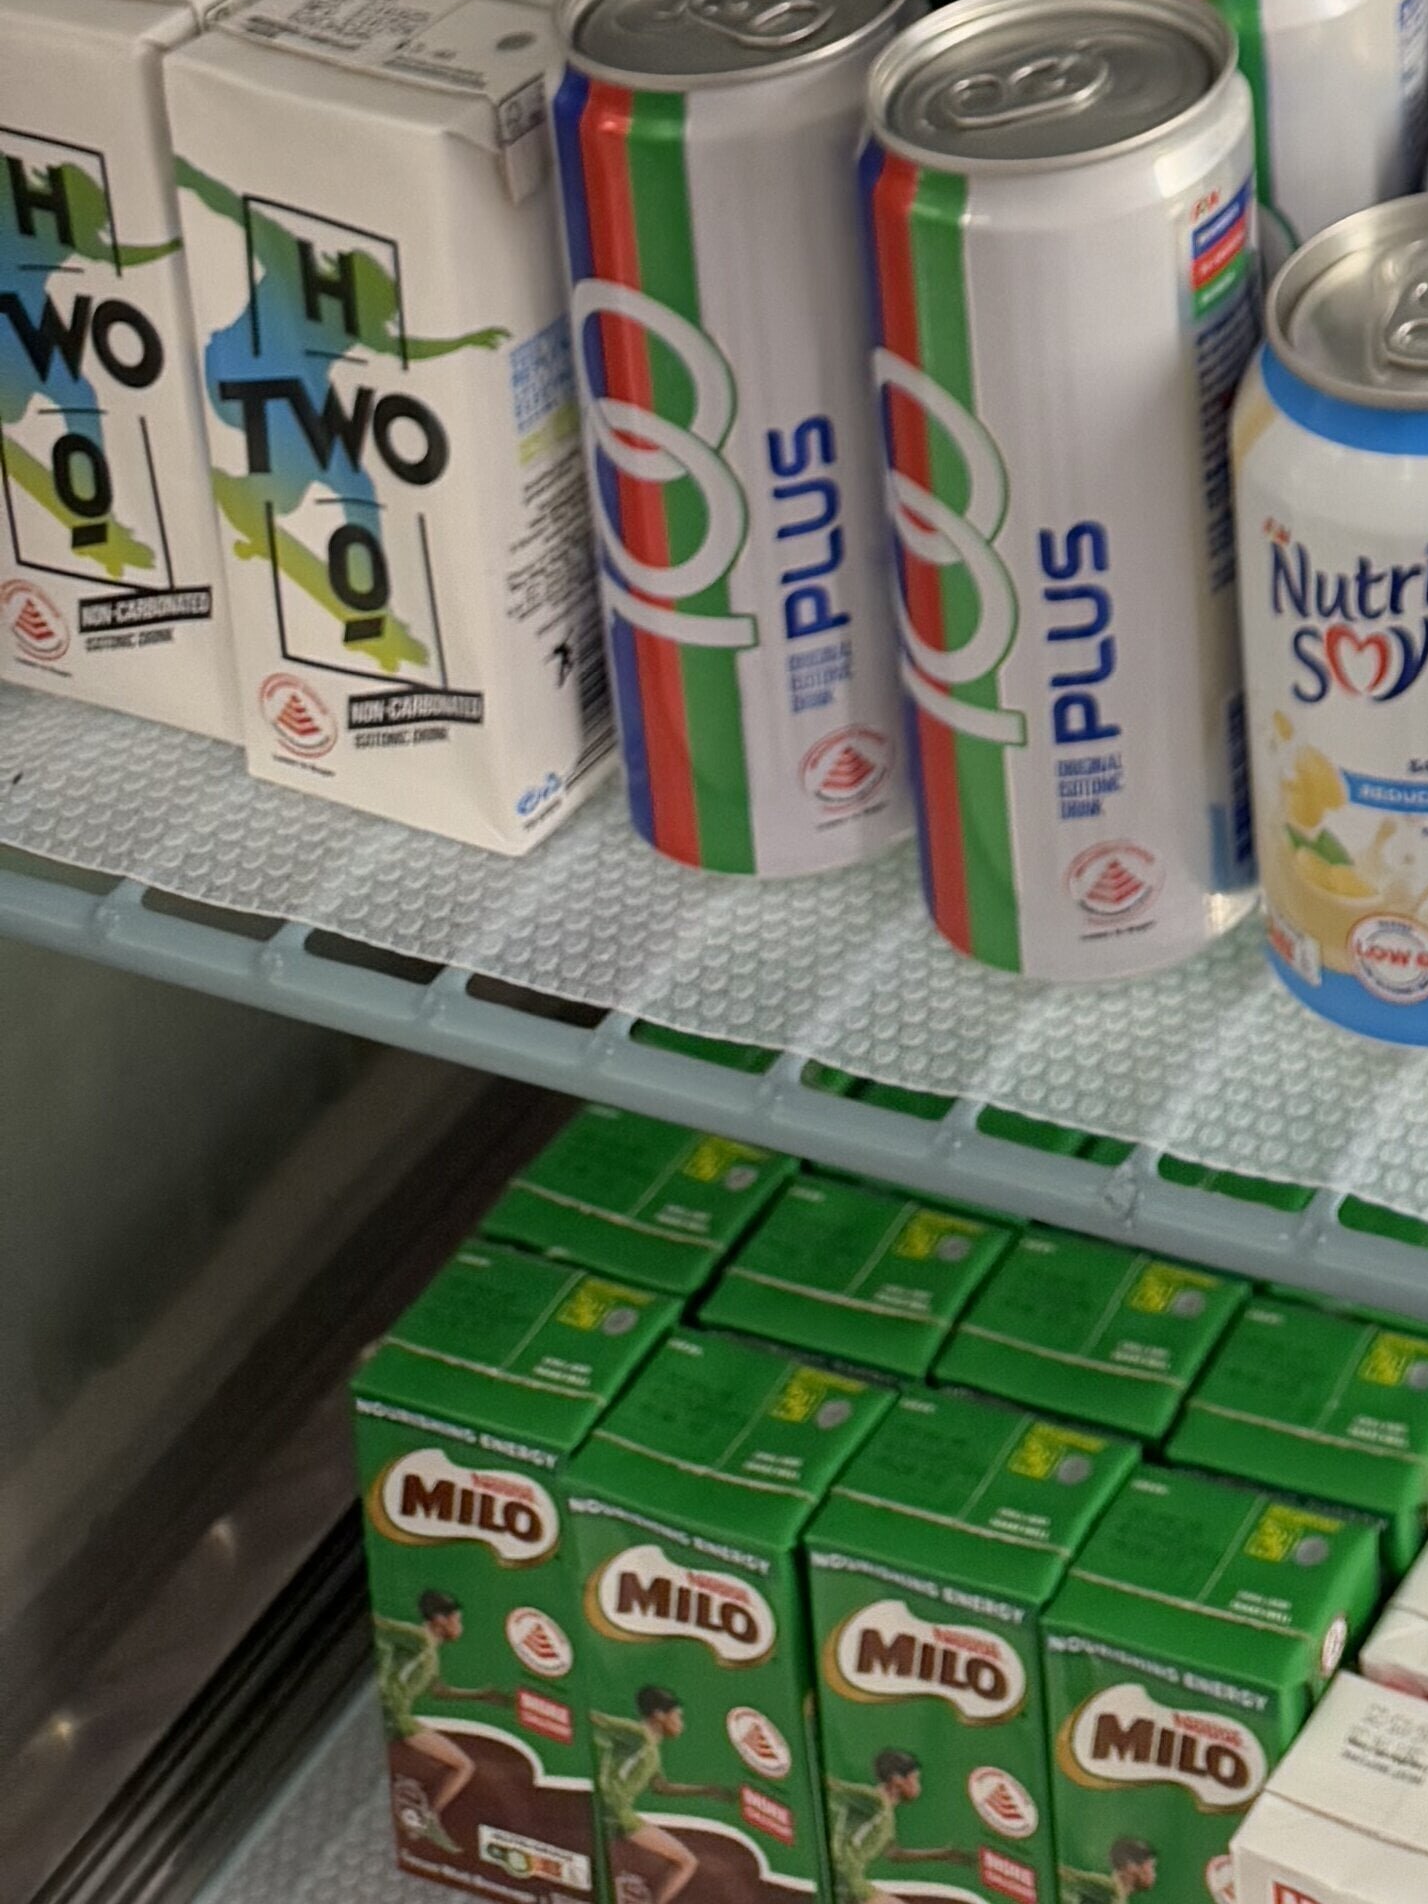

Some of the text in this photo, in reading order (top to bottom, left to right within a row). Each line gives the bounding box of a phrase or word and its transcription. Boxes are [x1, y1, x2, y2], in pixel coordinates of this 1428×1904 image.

[6, 152, 76, 248] H
[297, 238, 359, 339] H
[0, 292, 165, 391] WO
[219, 377, 449, 487] TWO
[326, 523, 391, 612] O
[767, 413, 851, 642] PLUS
[1040, 519, 1121, 747] PLUS
[349, 694, 483, 727] NON-CARBONATED
[400, 1473, 544, 1544] MILO
[615, 1570, 760, 1645] MILO
[855, 1627, 1010, 1702] MILO
[1091, 1712, 1250, 1791] MILO
